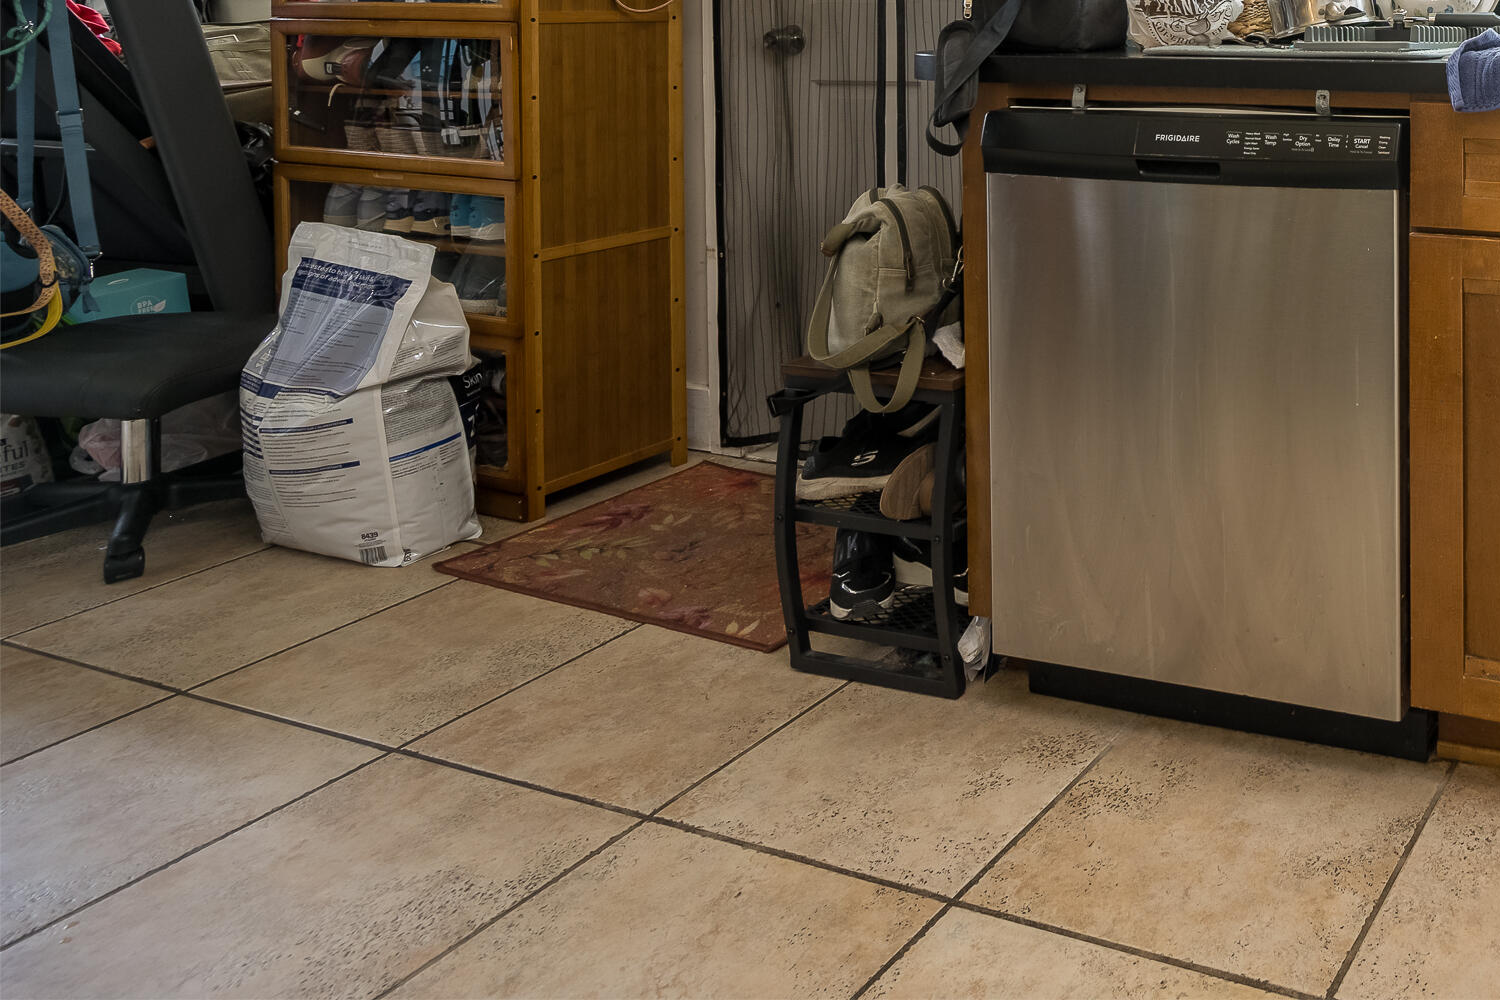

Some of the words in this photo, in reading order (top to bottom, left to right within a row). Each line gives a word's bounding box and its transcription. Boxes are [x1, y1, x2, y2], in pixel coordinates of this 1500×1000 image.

[1155, 133, 1200, 143] FRIGIDAIRE
[137, 299, 152, 309] BPA
[463, 373, 483, 389] Skin
[361, 531, 379, 540] 8439
